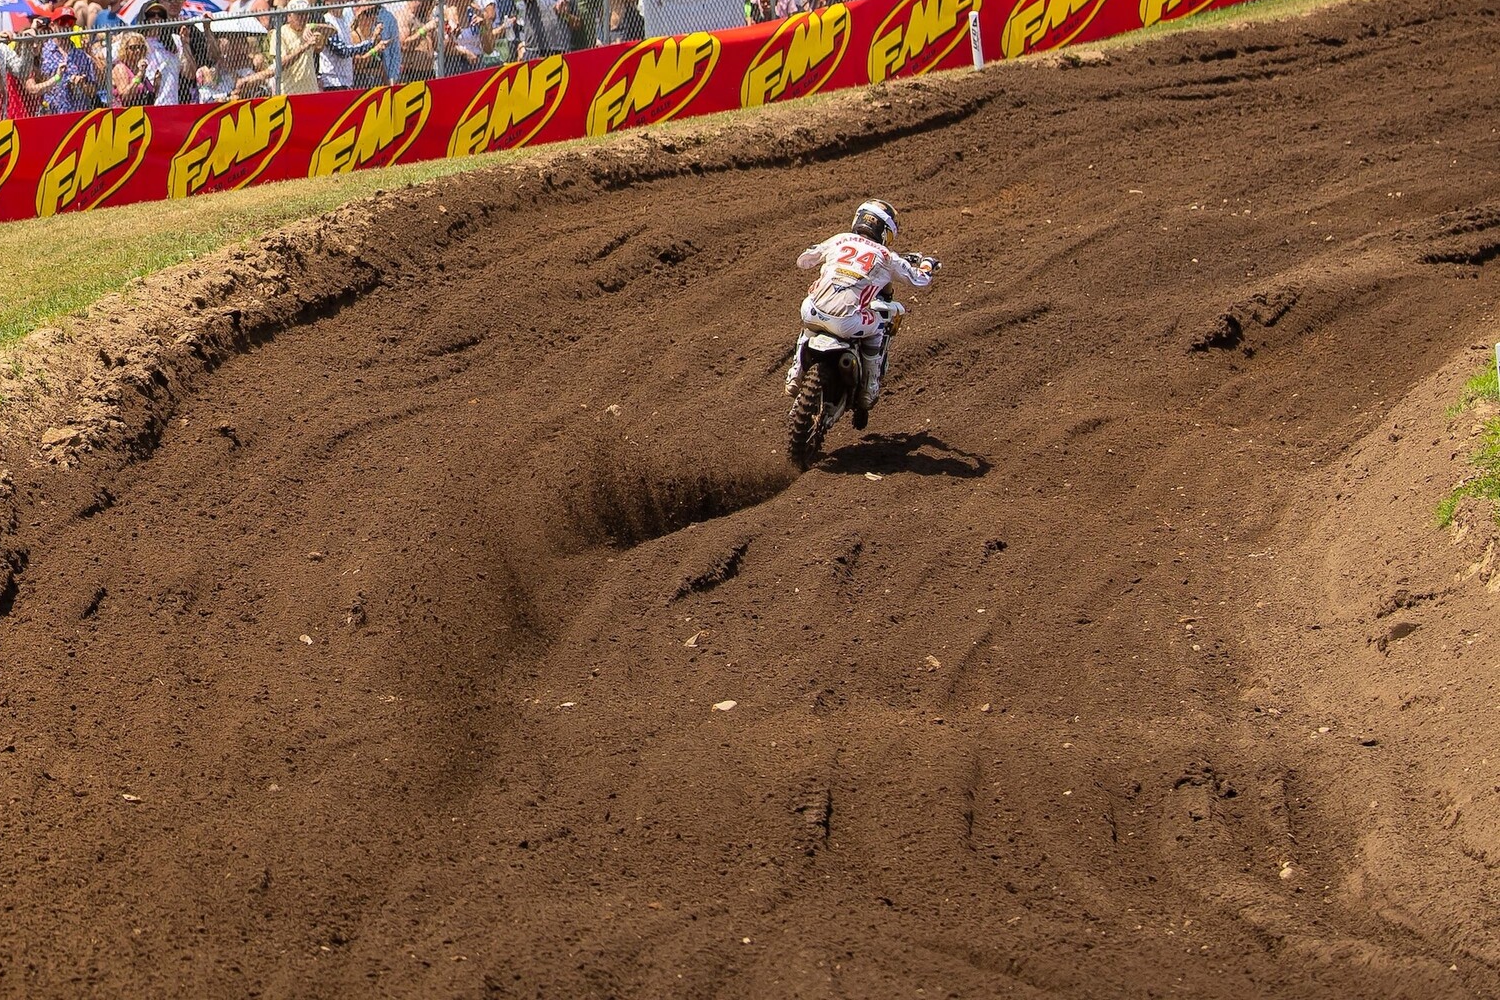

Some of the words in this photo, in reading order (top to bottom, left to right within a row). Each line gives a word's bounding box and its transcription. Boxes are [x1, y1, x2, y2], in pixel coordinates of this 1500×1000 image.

[453, 55, 563, 157] FMF
[594, 31, 713, 136] FMF
[748, 3, 846, 107] FMF
[40, 106, 144, 217] FMF
[172, 95, 287, 198] FMF
[315, 81, 425, 177] FMF
[837, 246, 876, 273] 24
